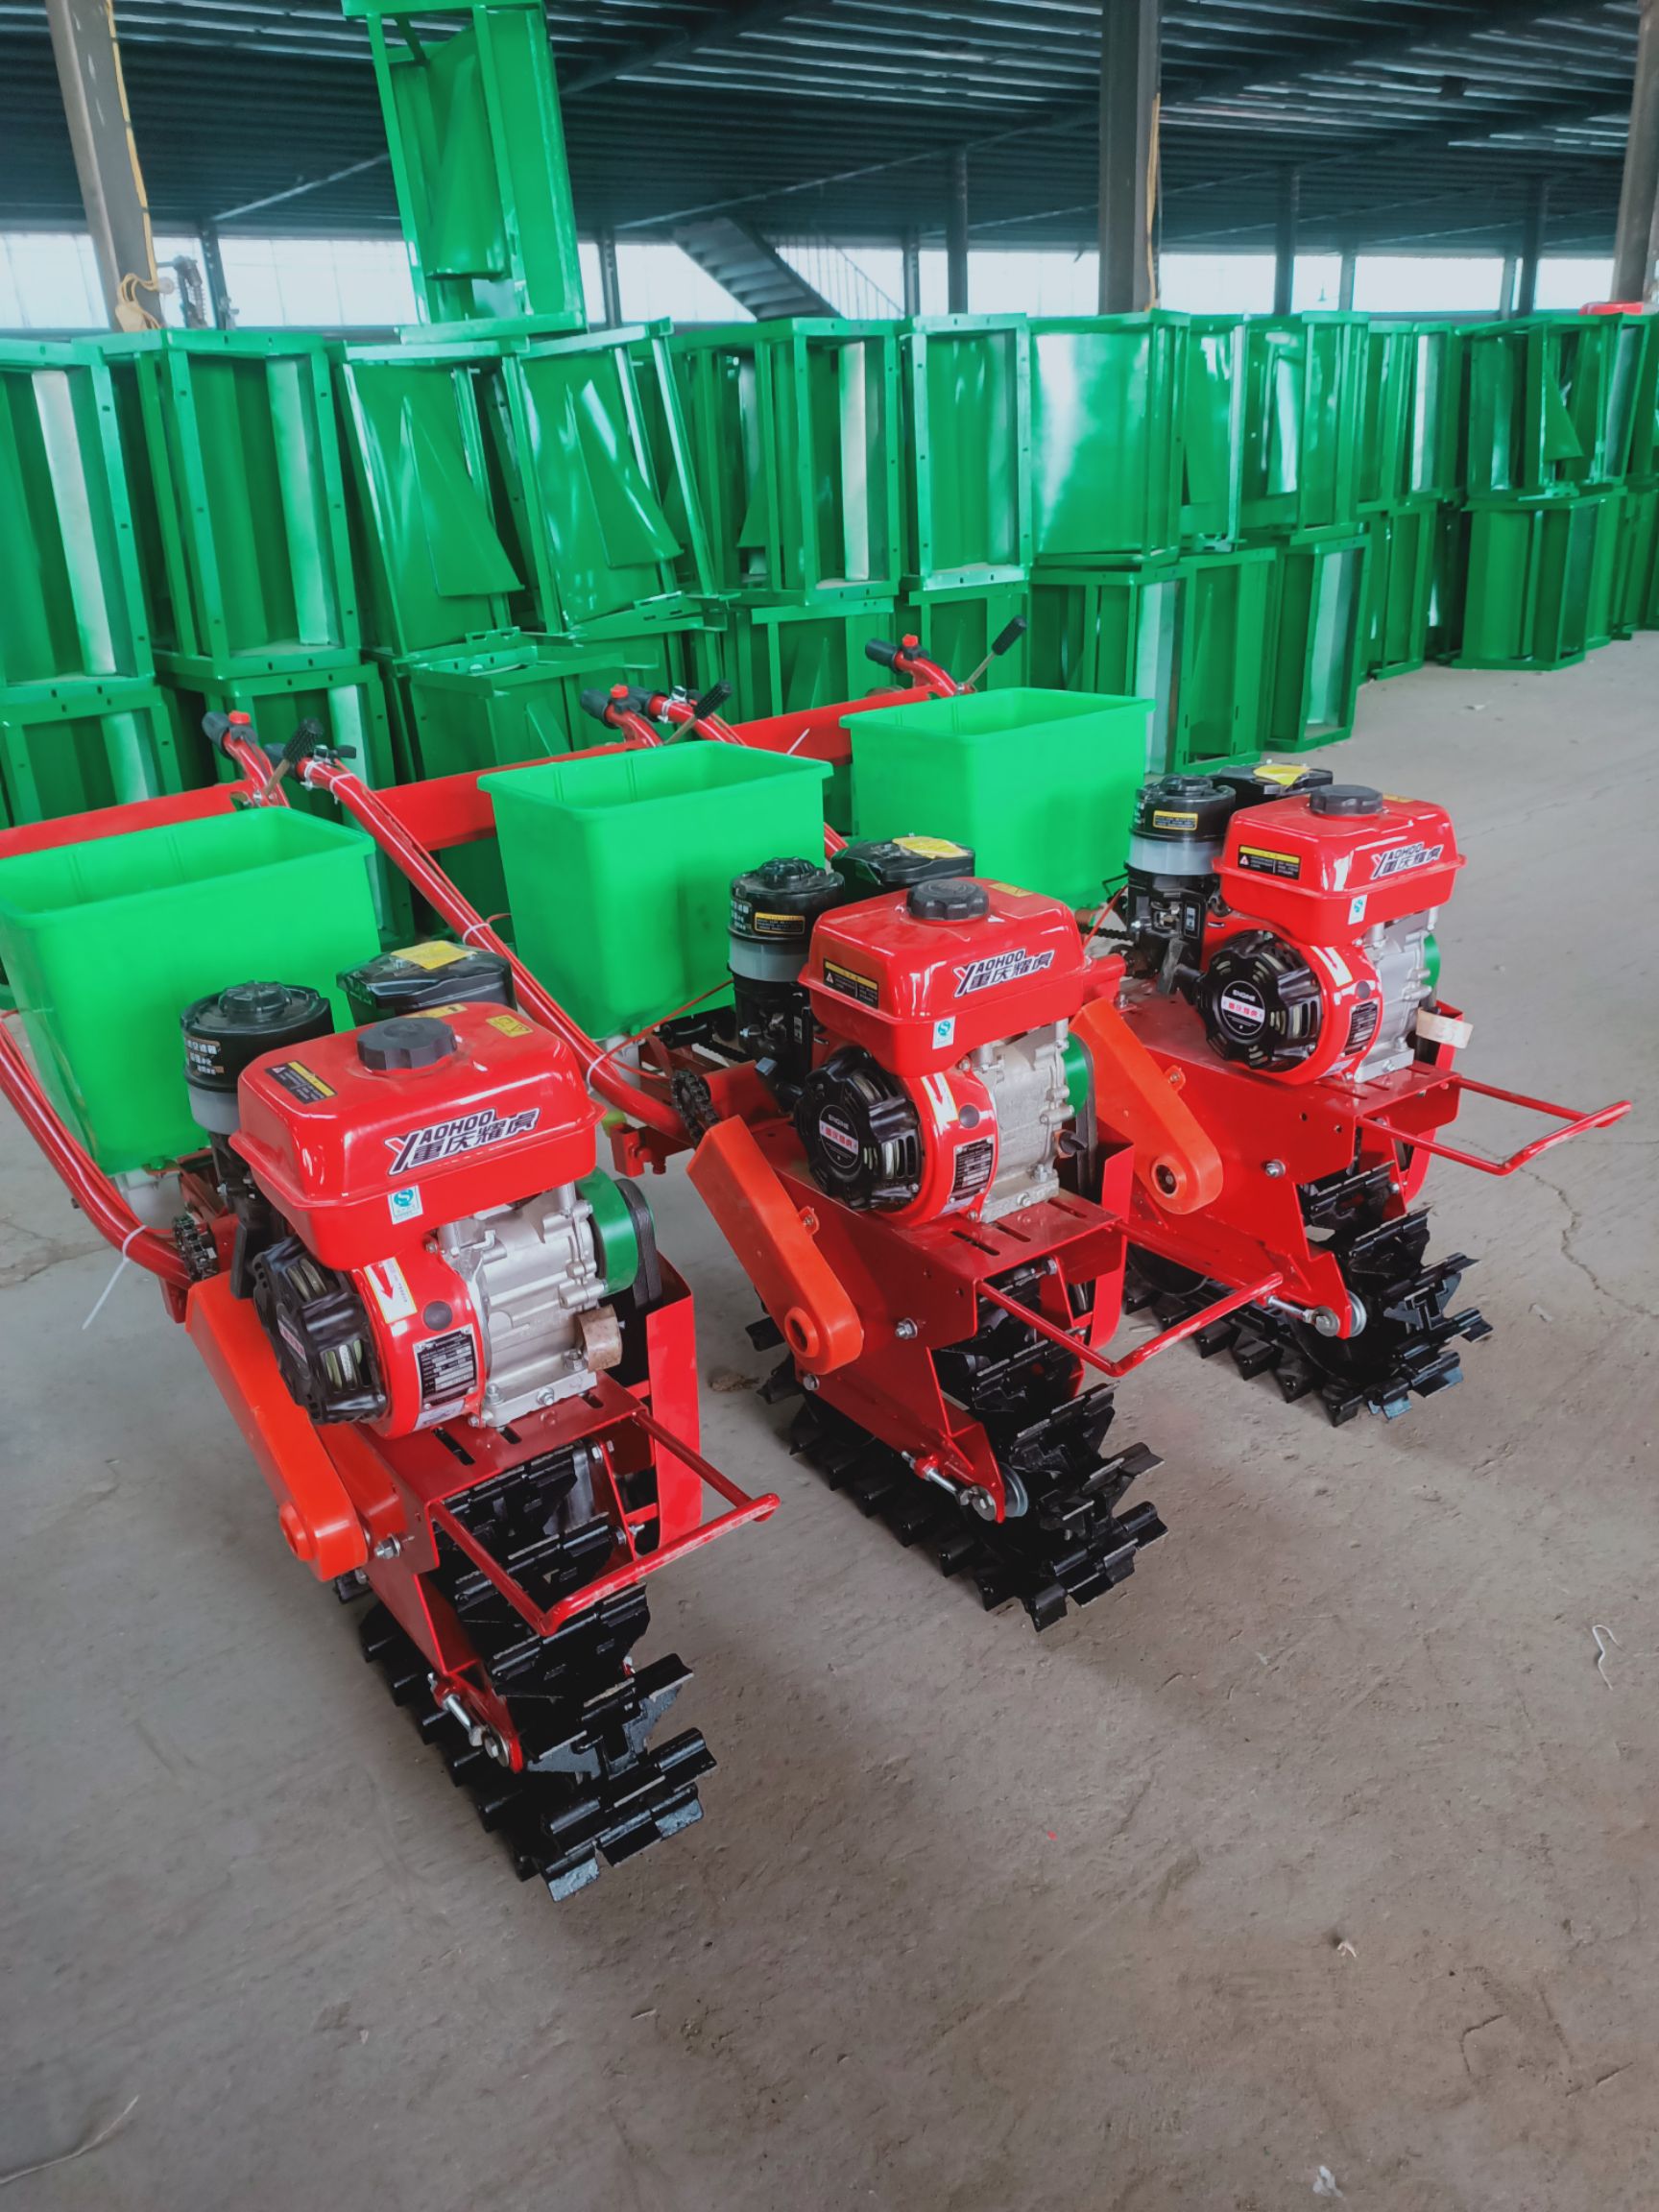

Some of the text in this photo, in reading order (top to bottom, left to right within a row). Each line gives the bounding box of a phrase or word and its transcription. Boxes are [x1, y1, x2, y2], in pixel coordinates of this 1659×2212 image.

[1372, 843, 1424, 878] YAOHOO
[955, 950, 1024, 996] YAOHOO
[968, 951, 1053, 991] 重庆耀虎
[386, 1110, 494, 1173] YAOHOO
[410, 1110, 539, 1166] 重庆耀虎
